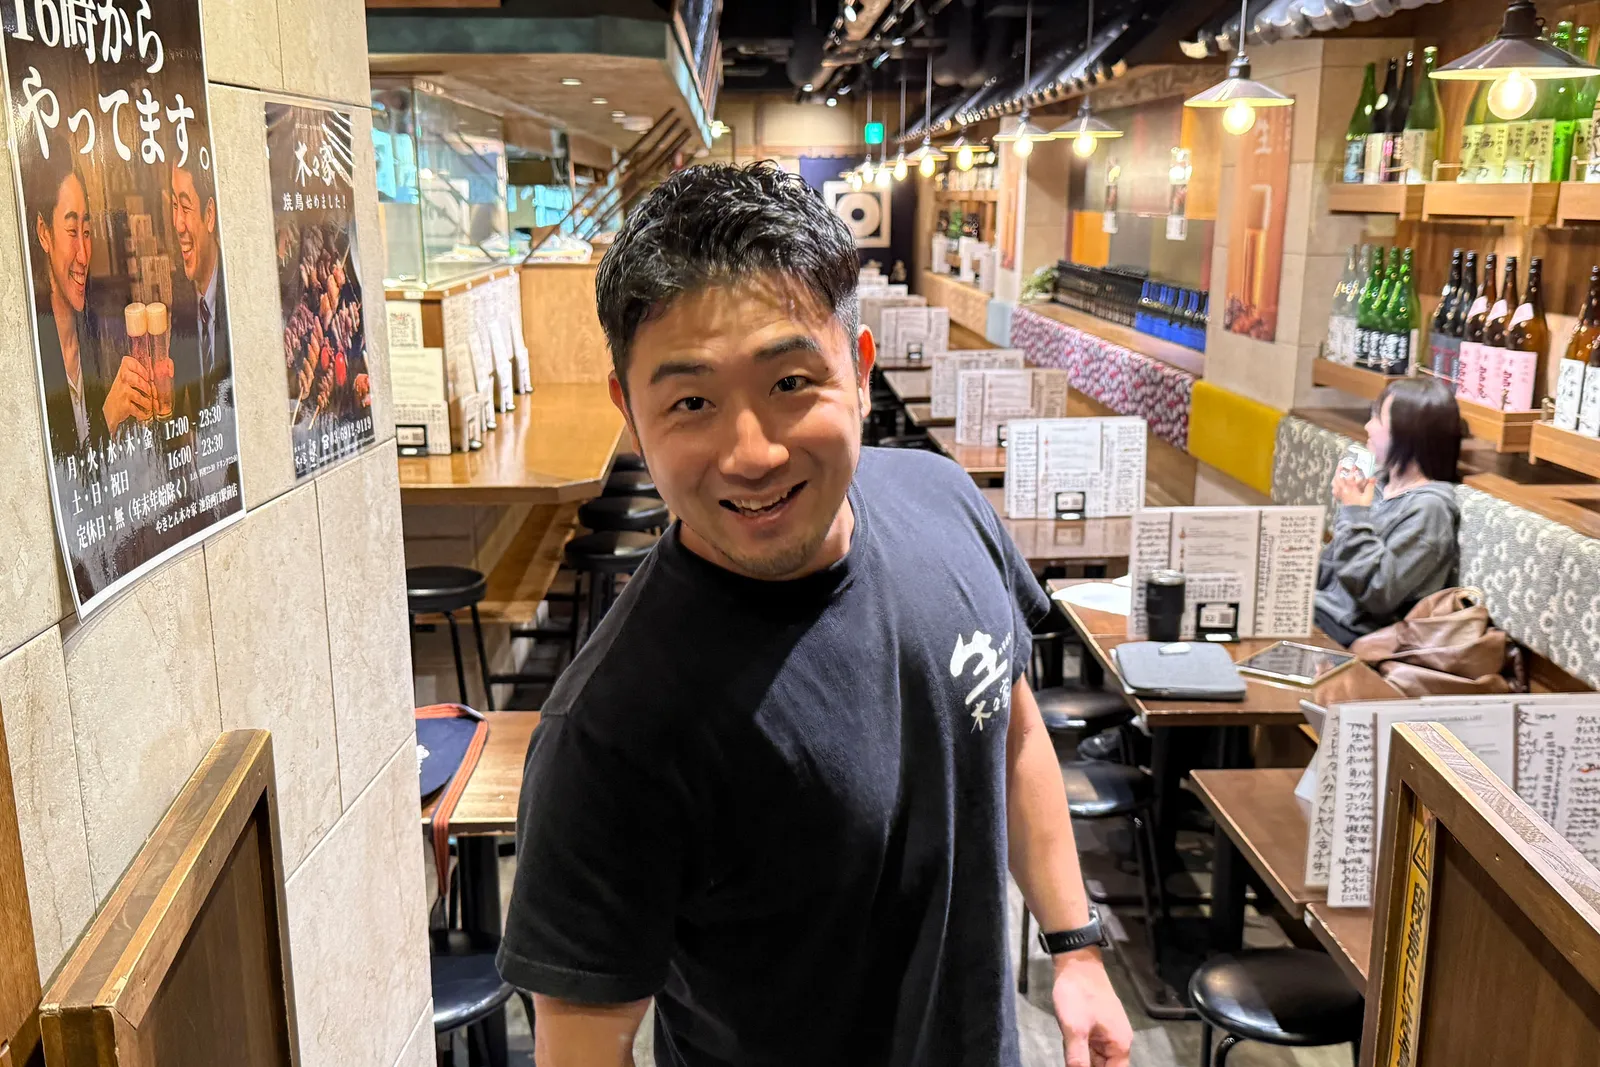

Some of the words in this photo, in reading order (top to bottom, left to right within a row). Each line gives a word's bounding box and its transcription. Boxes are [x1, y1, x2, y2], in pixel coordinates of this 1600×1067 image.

[18, 66, 210, 170] やってます。
[165, 415, 190, 440] 17:00
[199, 404, 223, 428] 23:30
[167, 445, 192, 471] 16:00
[201, 433, 224, 457] 23:30
